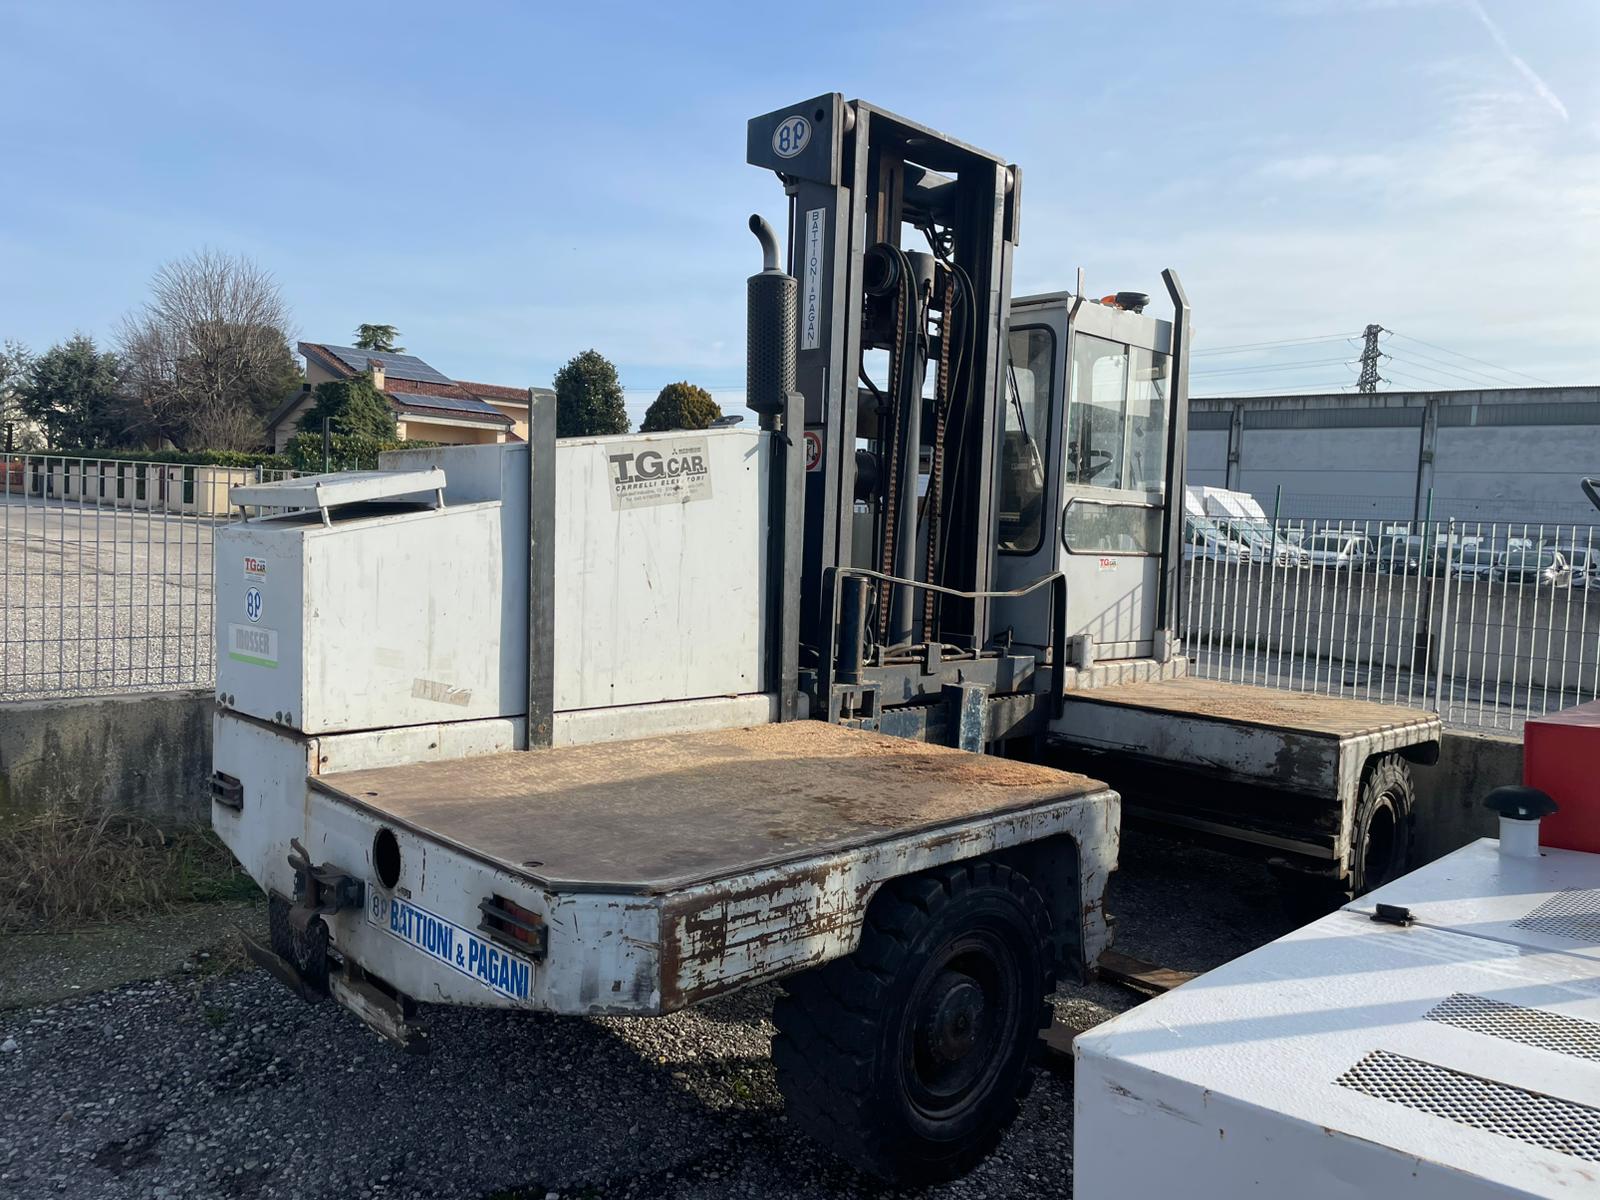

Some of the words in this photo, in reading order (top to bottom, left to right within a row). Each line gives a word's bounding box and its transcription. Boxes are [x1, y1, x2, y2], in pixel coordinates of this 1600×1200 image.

[779, 121, 805, 151] BP
[810, 211, 819, 283] BATTIONI
[807, 295, 816, 348] PAGANI
[615, 482, 657, 493] CARRELLI
[245, 558, 257, 572] TG
[1099, 558, 1109, 567] TG
[247, 592, 261, 617] BP
[236, 629, 269, 655] MOSSER
[390, 900, 453, 961] BATTIONI
[456, 943, 465, 968] &
[469, 938, 529, 999] PAGANI
